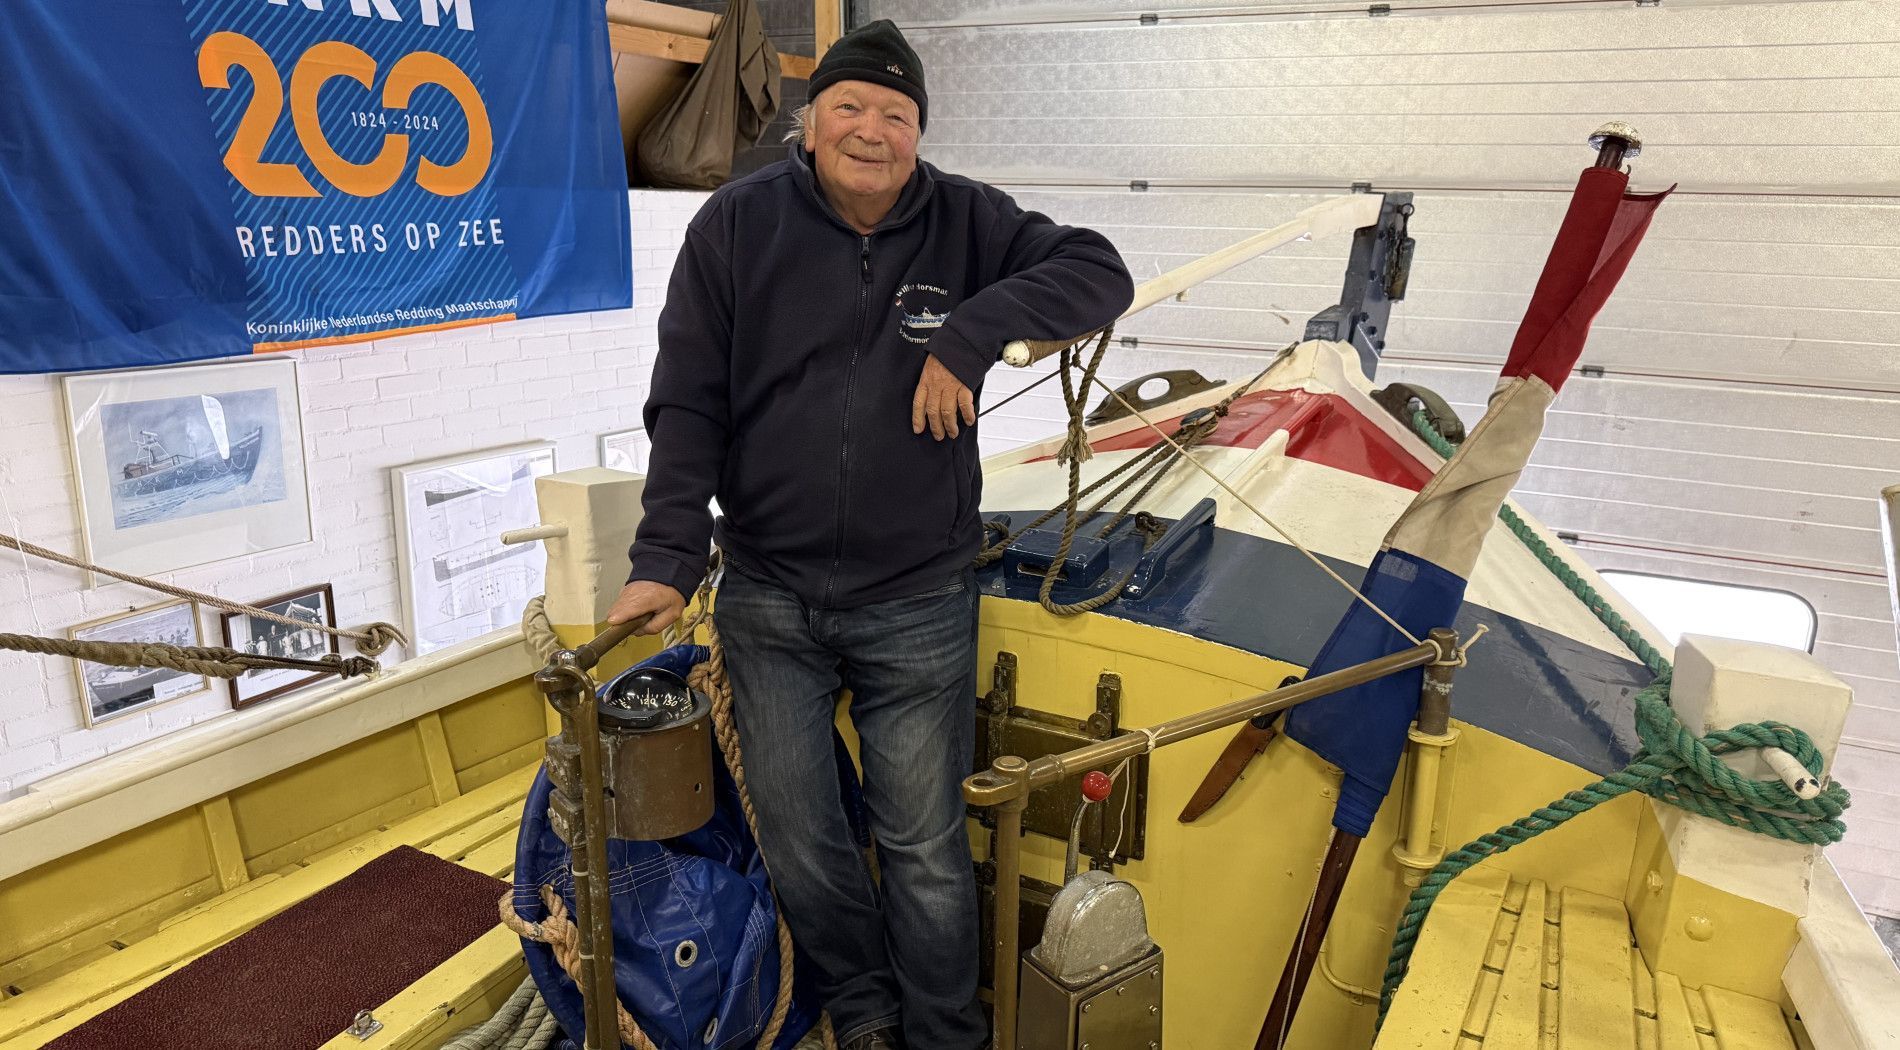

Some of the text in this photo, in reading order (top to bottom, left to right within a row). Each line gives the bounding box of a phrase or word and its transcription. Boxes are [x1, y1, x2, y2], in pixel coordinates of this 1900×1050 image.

[197, 31, 494, 198] 200
[351, 111, 386, 128] 1824
[403, 114, 439, 130] 2024
[235, 218, 505, 258] REDDERS OP ZEE
[246, 316, 328, 335] Koninklijke
[328, 311, 395, 328] Nederlandse
[394, 306, 445, 321] Redding
